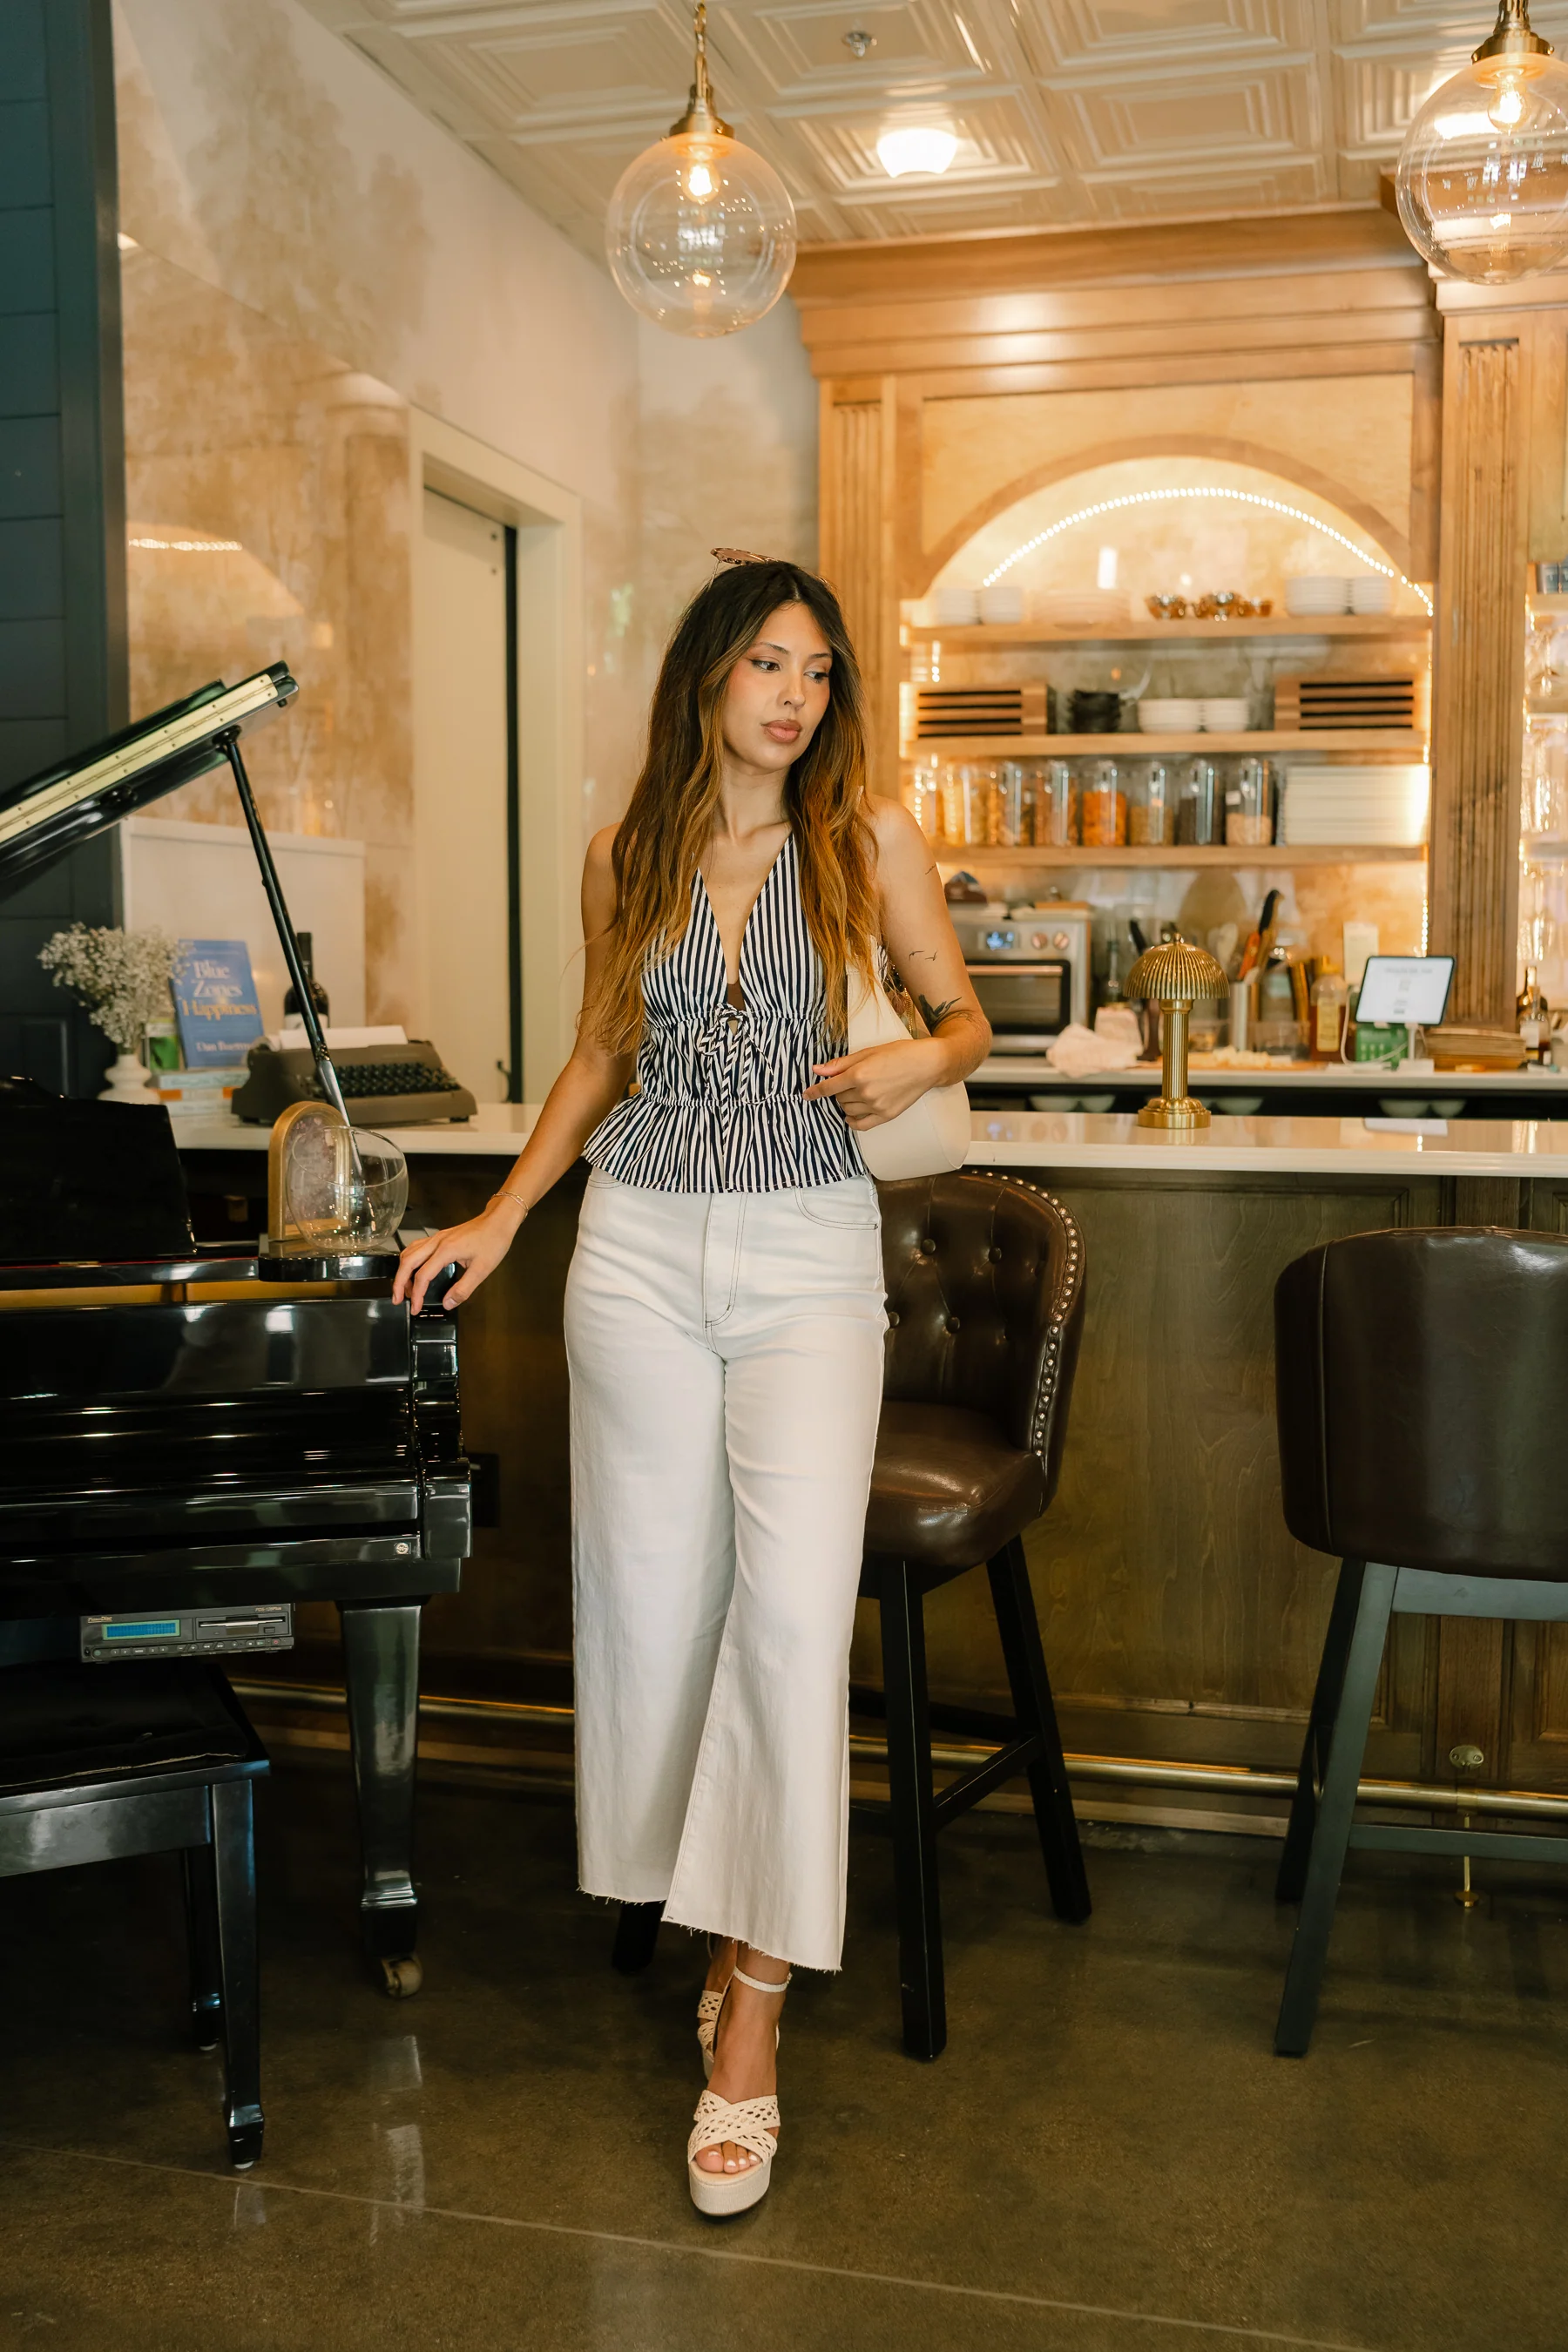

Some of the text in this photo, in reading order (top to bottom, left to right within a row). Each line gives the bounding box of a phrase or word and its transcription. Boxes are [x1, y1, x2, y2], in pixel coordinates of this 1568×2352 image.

[193, 960, 230, 978] Blue
[192, 980, 243, 997] Zones
[182, 999, 257, 1020] Happiness
